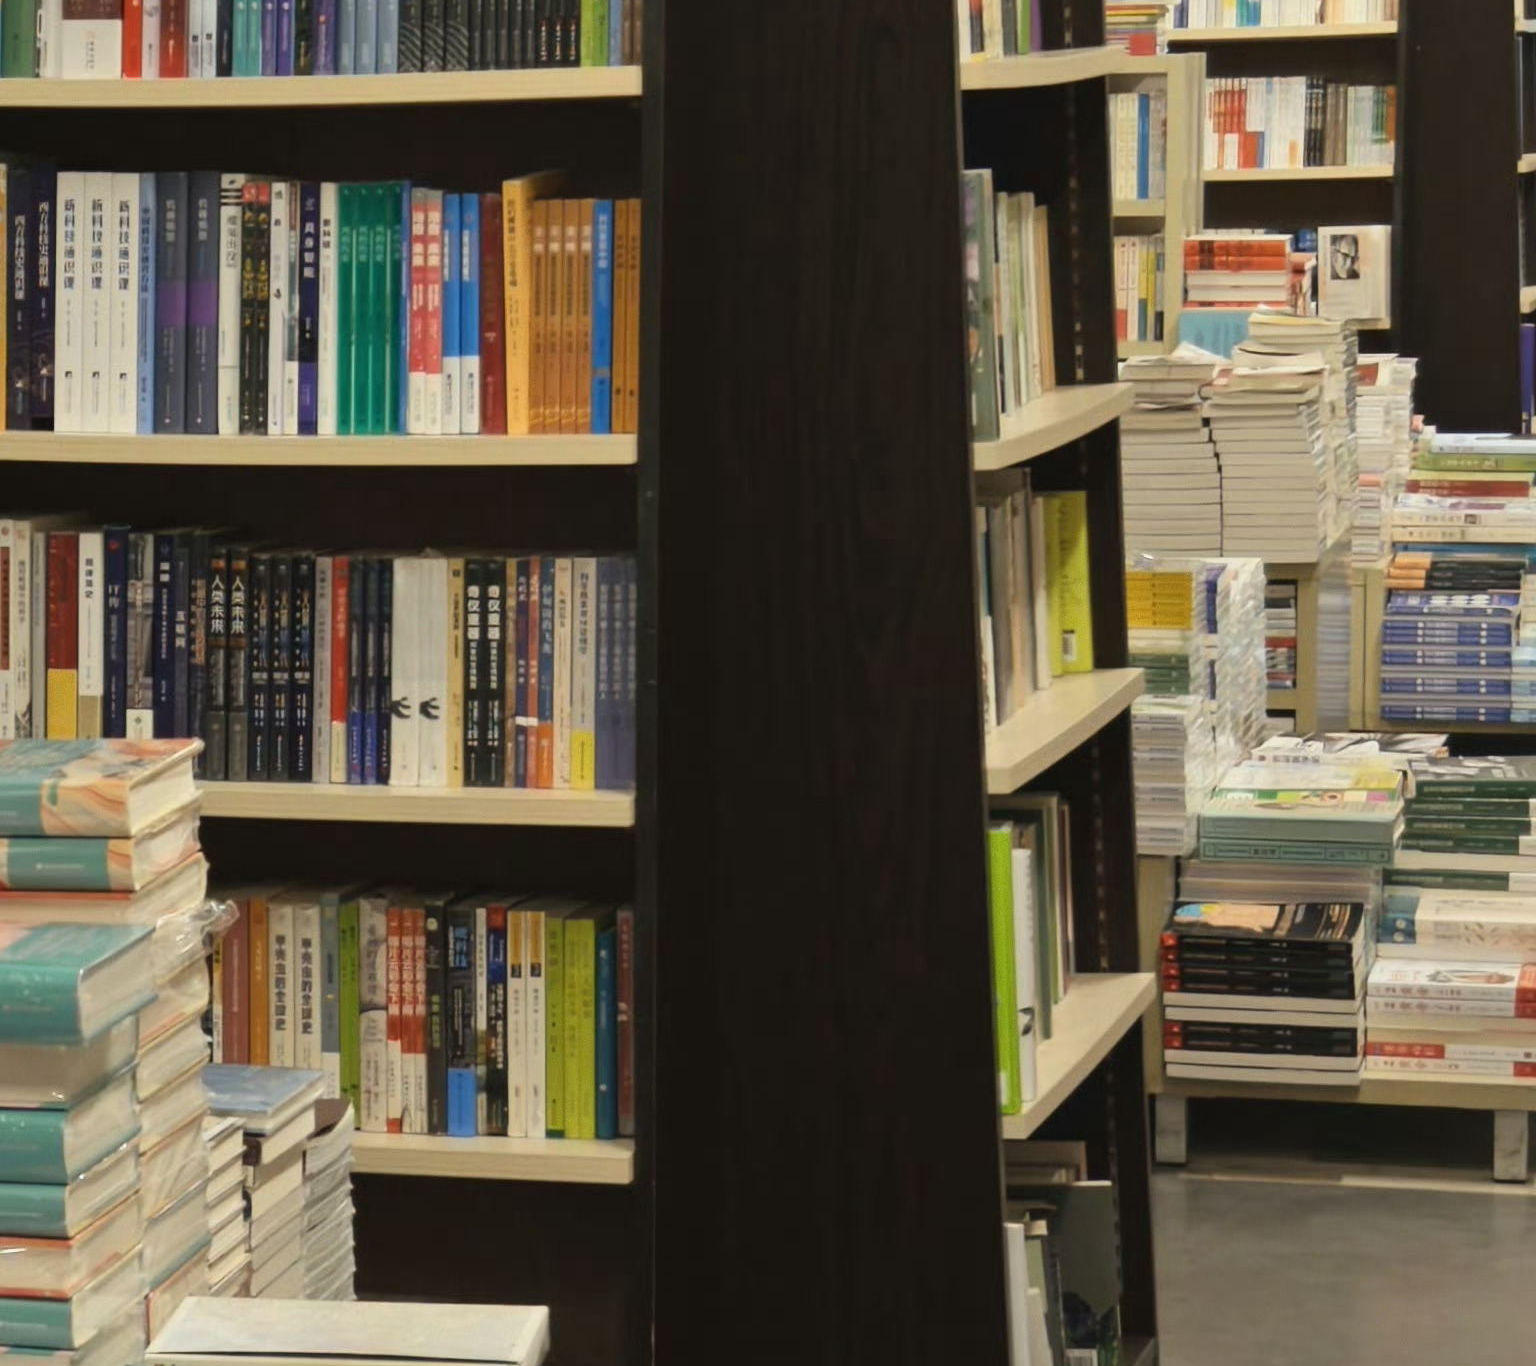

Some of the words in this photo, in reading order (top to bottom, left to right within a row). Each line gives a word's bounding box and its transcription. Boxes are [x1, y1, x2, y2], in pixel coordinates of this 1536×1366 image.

[210, 575, 226, 635] 人类未来
[230, 575, 246, 635] 人类未来
